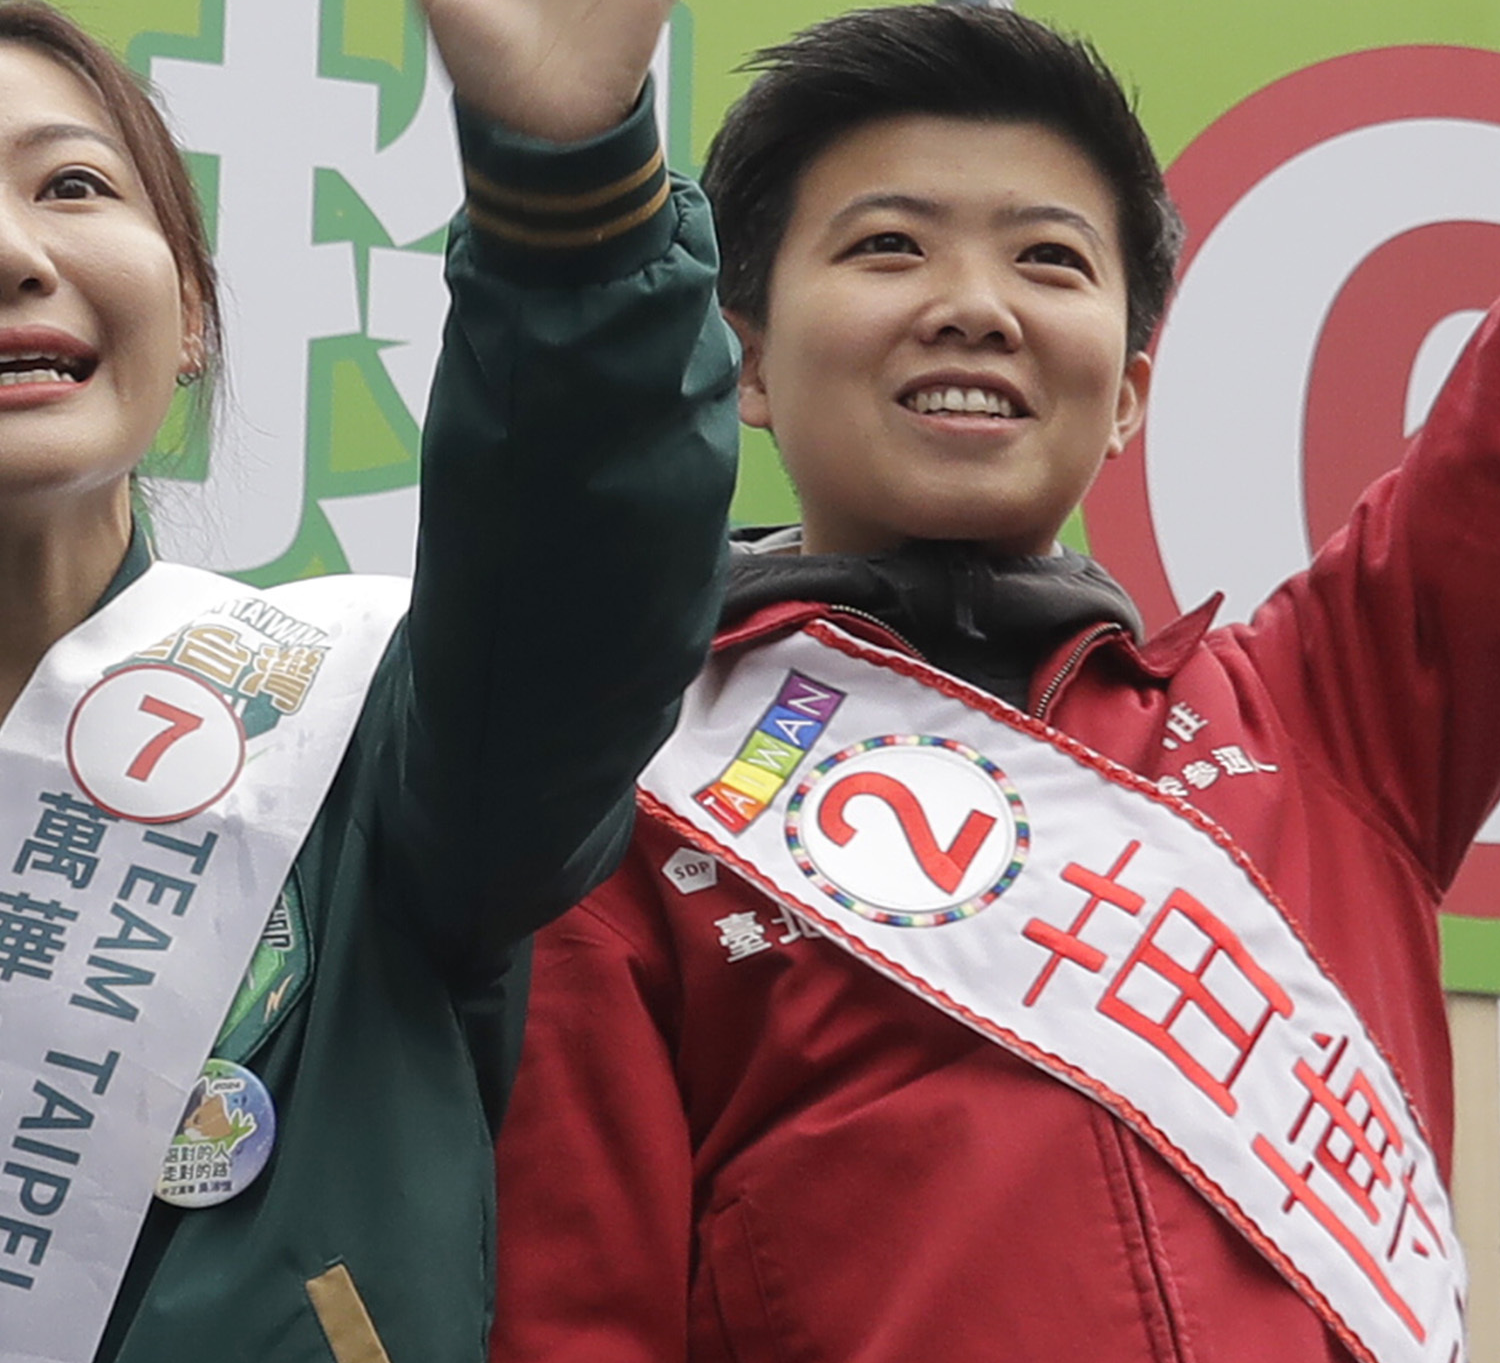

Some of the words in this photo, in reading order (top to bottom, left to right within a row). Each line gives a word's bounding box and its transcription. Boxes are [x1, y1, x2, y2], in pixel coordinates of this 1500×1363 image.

[125, 694, 205, 783] 7
[702, 683, 835, 826] TAIWAN
[674, 859, 711, 881] SDP
[817, 770, 998, 895] 2
[69, 830, 218, 1025] TEAM
